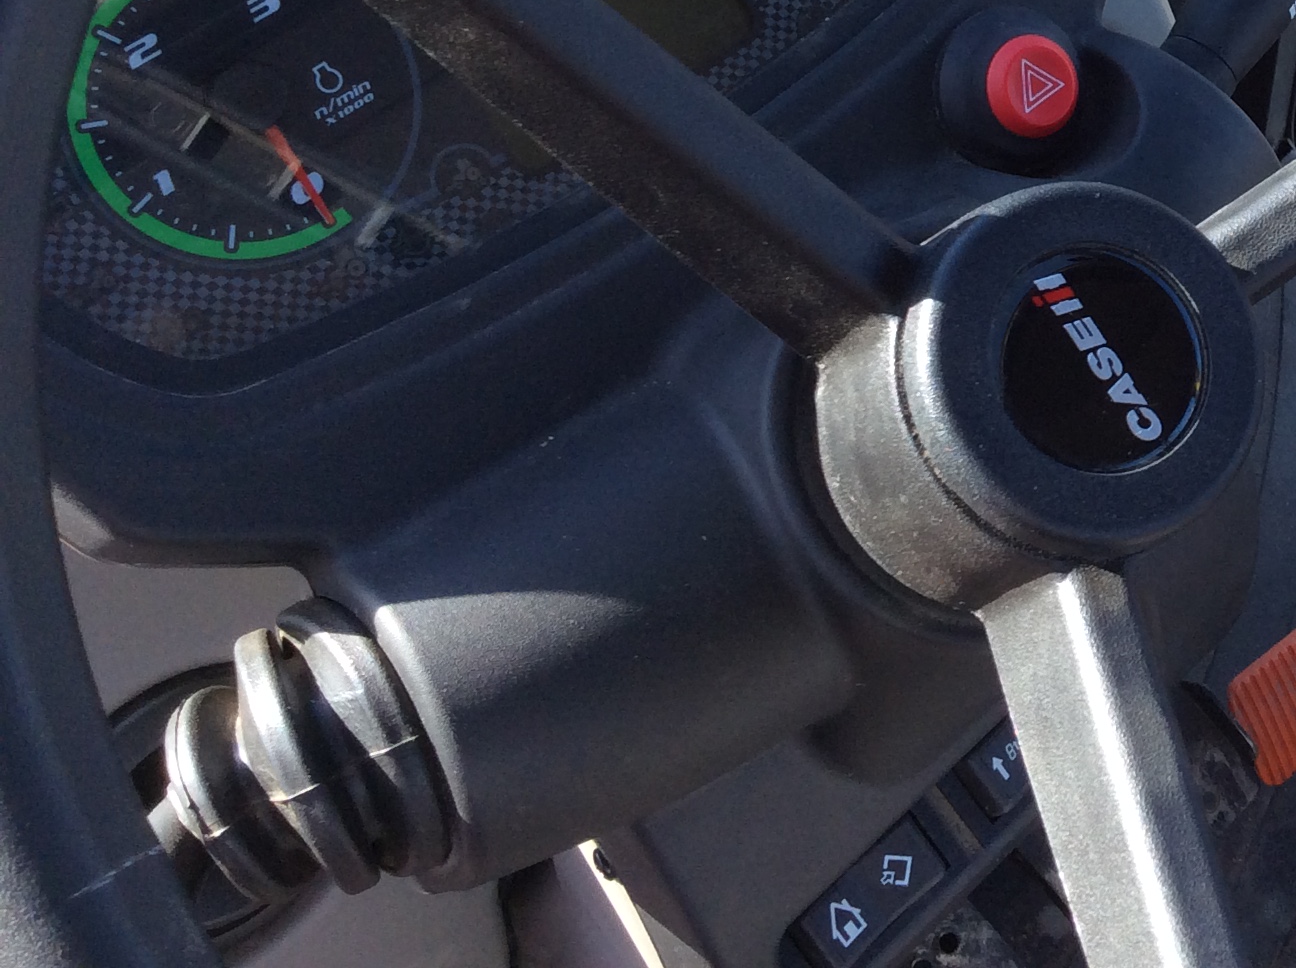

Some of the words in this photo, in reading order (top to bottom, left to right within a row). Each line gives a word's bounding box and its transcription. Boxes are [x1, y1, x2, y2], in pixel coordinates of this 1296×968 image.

[123, 33, 162, 70] 2
[313, 80, 372, 120] n/min
[152, 169, 176, 197] 1
